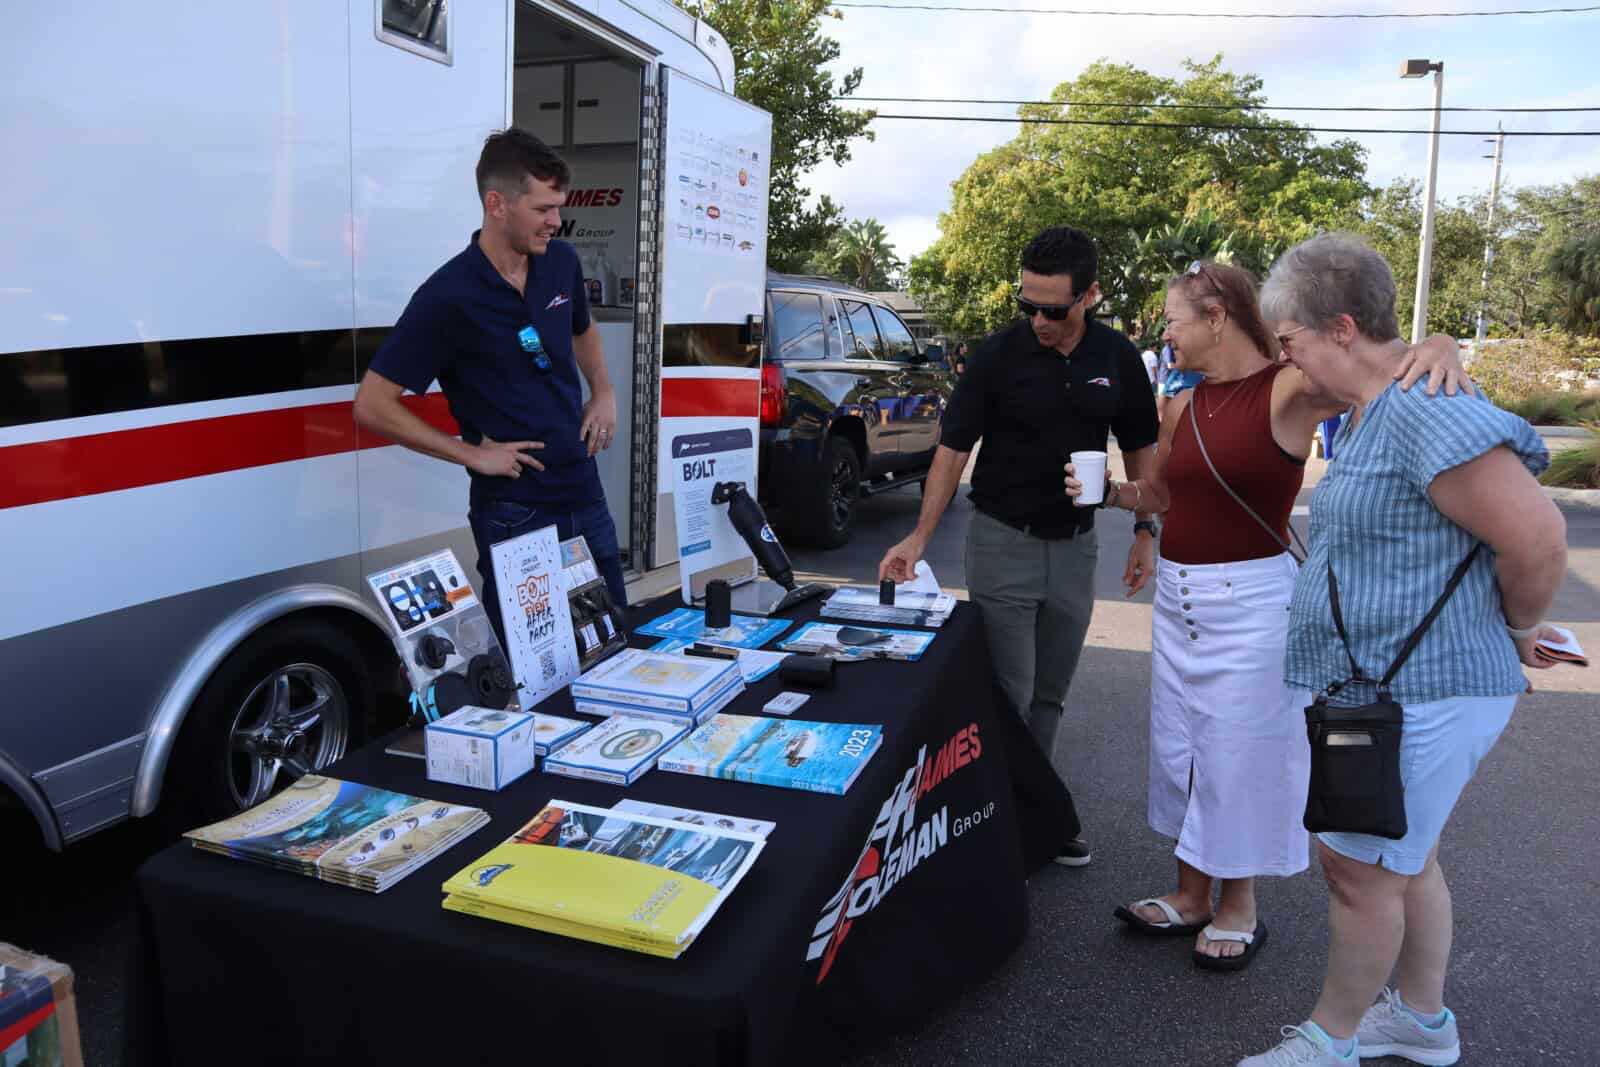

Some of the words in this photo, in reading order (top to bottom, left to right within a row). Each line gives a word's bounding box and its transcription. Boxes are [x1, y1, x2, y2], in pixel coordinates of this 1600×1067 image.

[564, 188, 624, 208] IMES
[683, 458, 716, 482] BOLT
[527, 606, 554, 629] AFTER
[529, 620, 555, 644] PARTY
[839, 729, 872, 758] 2023
[952, 801, 995, 838] GROUP
